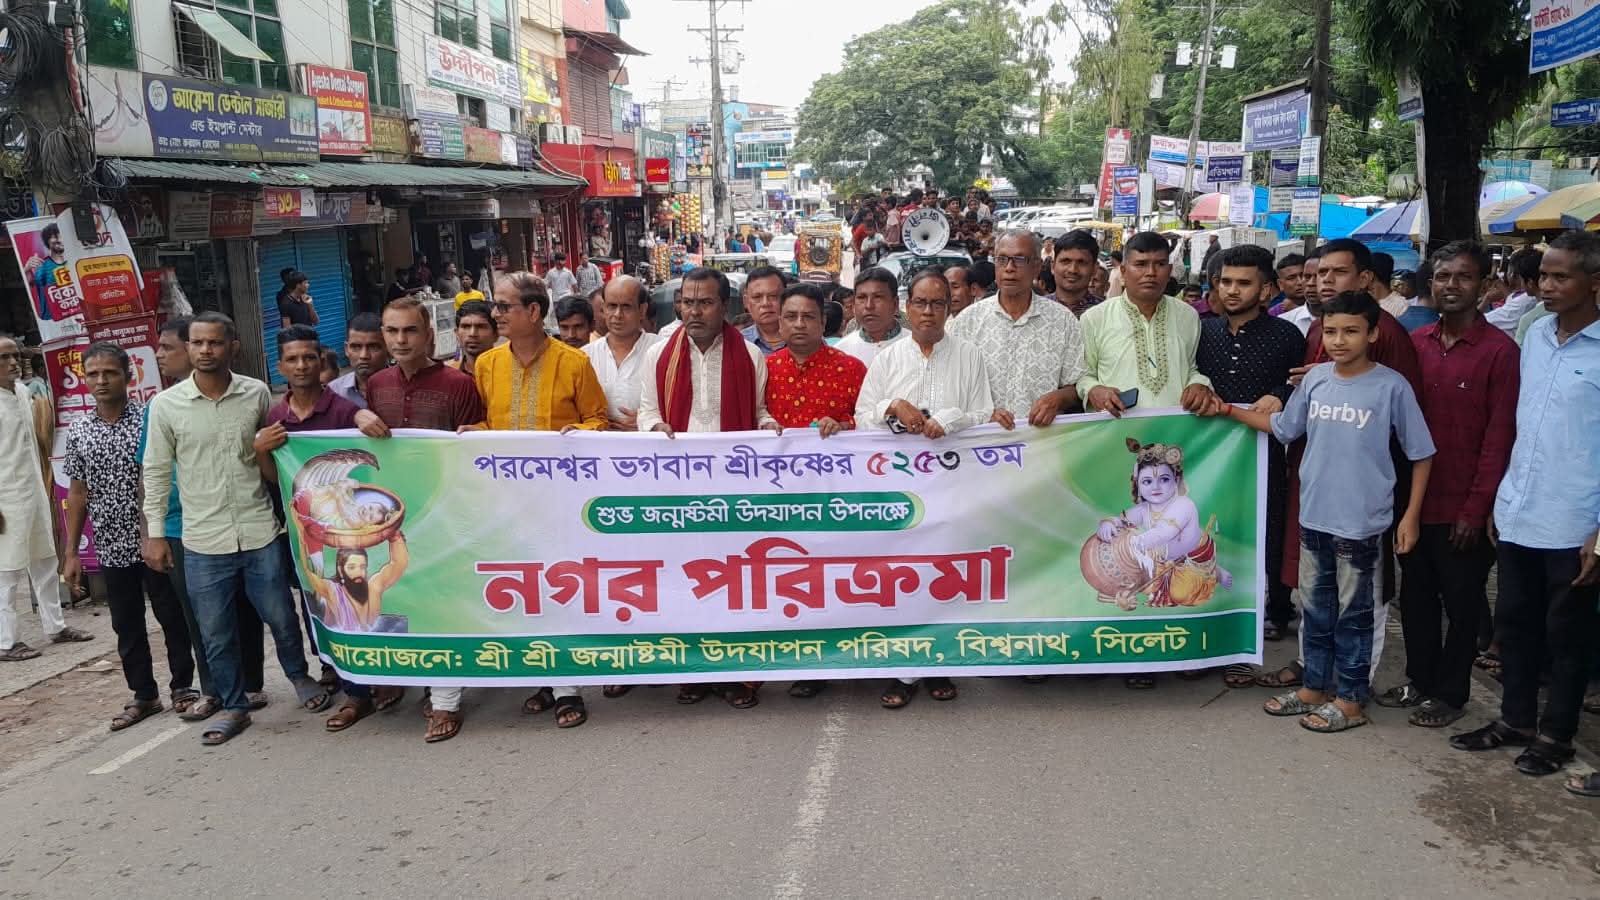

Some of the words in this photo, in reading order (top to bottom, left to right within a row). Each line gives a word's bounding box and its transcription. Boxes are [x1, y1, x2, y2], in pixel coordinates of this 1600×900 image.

[438, 44, 496, 85] উদ্দীপন
[172, 88, 214, 113] আয়েশা
[218, 90, 252, 115] ডেন্টাল
[1309, 400, 1372, 429] Derby
[474, 453, 601, 481] পরমেশ্বর
[609, 452, 716, 480] ভগবান
[724, 444, 855, 488] শ্রীকৃষ্ণের
[866, 451, 961, 477] ৫২৫৩
[972, 443, 1026, 468] তম
[596, 505, 634, 526] শুভ
[735, 499, 823, 523] উদযাপন
[828, 498, 910, 521] উপলক্ষে
[476, 557, 664, 622] নগর
[682, 536, 1012, 619] পরিক্রমা
[475, 641, 510, 671] শ্রী
[521, 638, 561, 669] শ্রী
[568, 637, 692, 670] জন্মাষ্টমী
[698, 637, 826, 663] উদযাপন
[836, 631, 944, 663] পরিষদ,
[955, 628, 1080, 661] বিশ্বনাথ,
[1091, 624, 1191, 655] সিলেট
